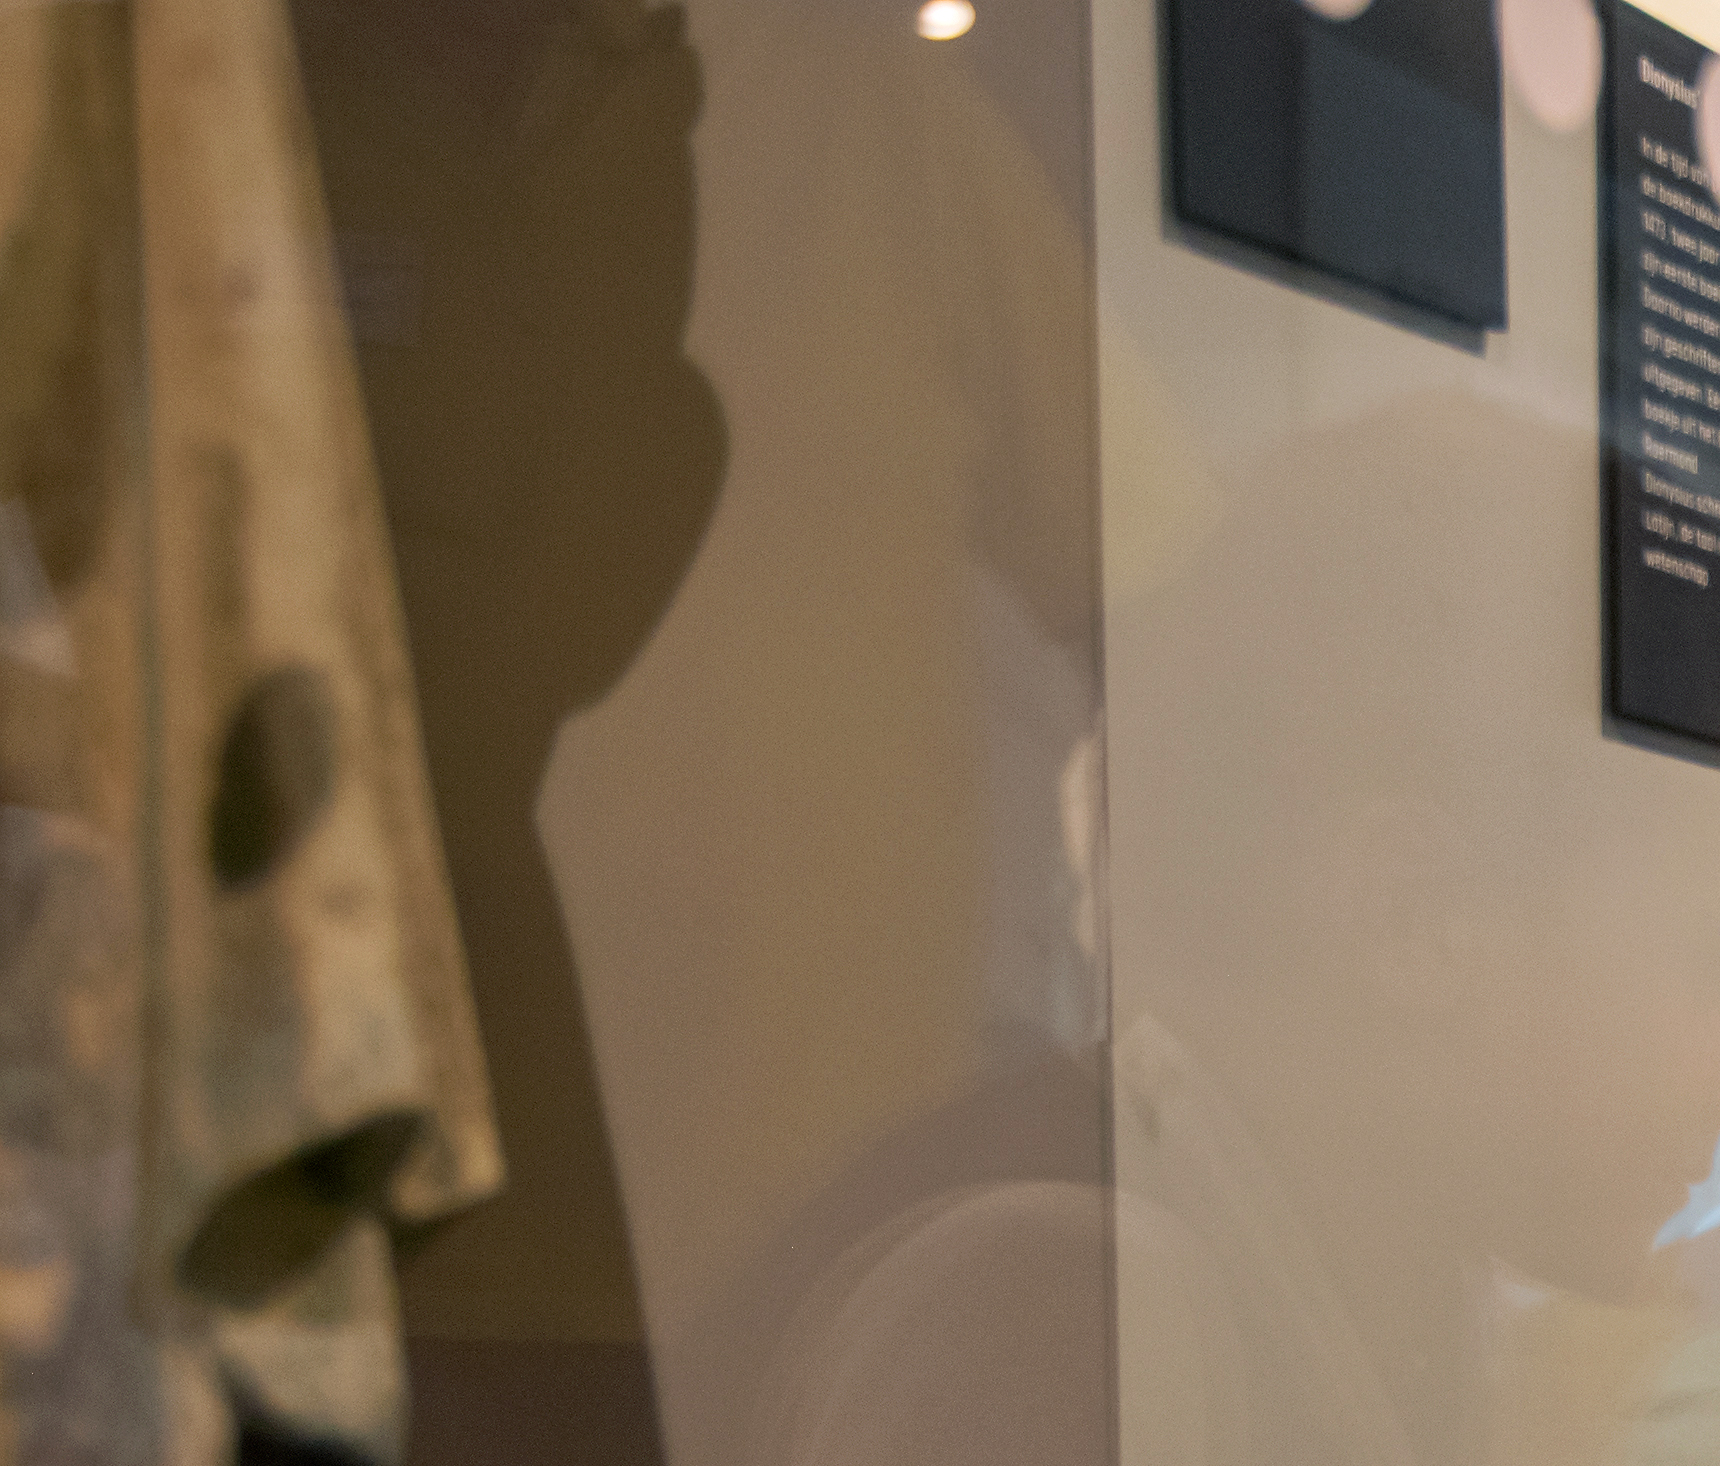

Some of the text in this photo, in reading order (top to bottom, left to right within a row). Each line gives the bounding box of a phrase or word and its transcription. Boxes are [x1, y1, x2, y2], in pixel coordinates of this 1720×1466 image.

[1643, 176, 1657, 202] de
[1671, 224, 1696, 255] twee
[1643, 253, 1662, 278] zijn
[1665, 264, 1697, 293] eerste
[1644, 327, 1662, 353] zijn
[1645, 470, 1694, 509] Dionysius
[1680, 522, 1694, 546] de
